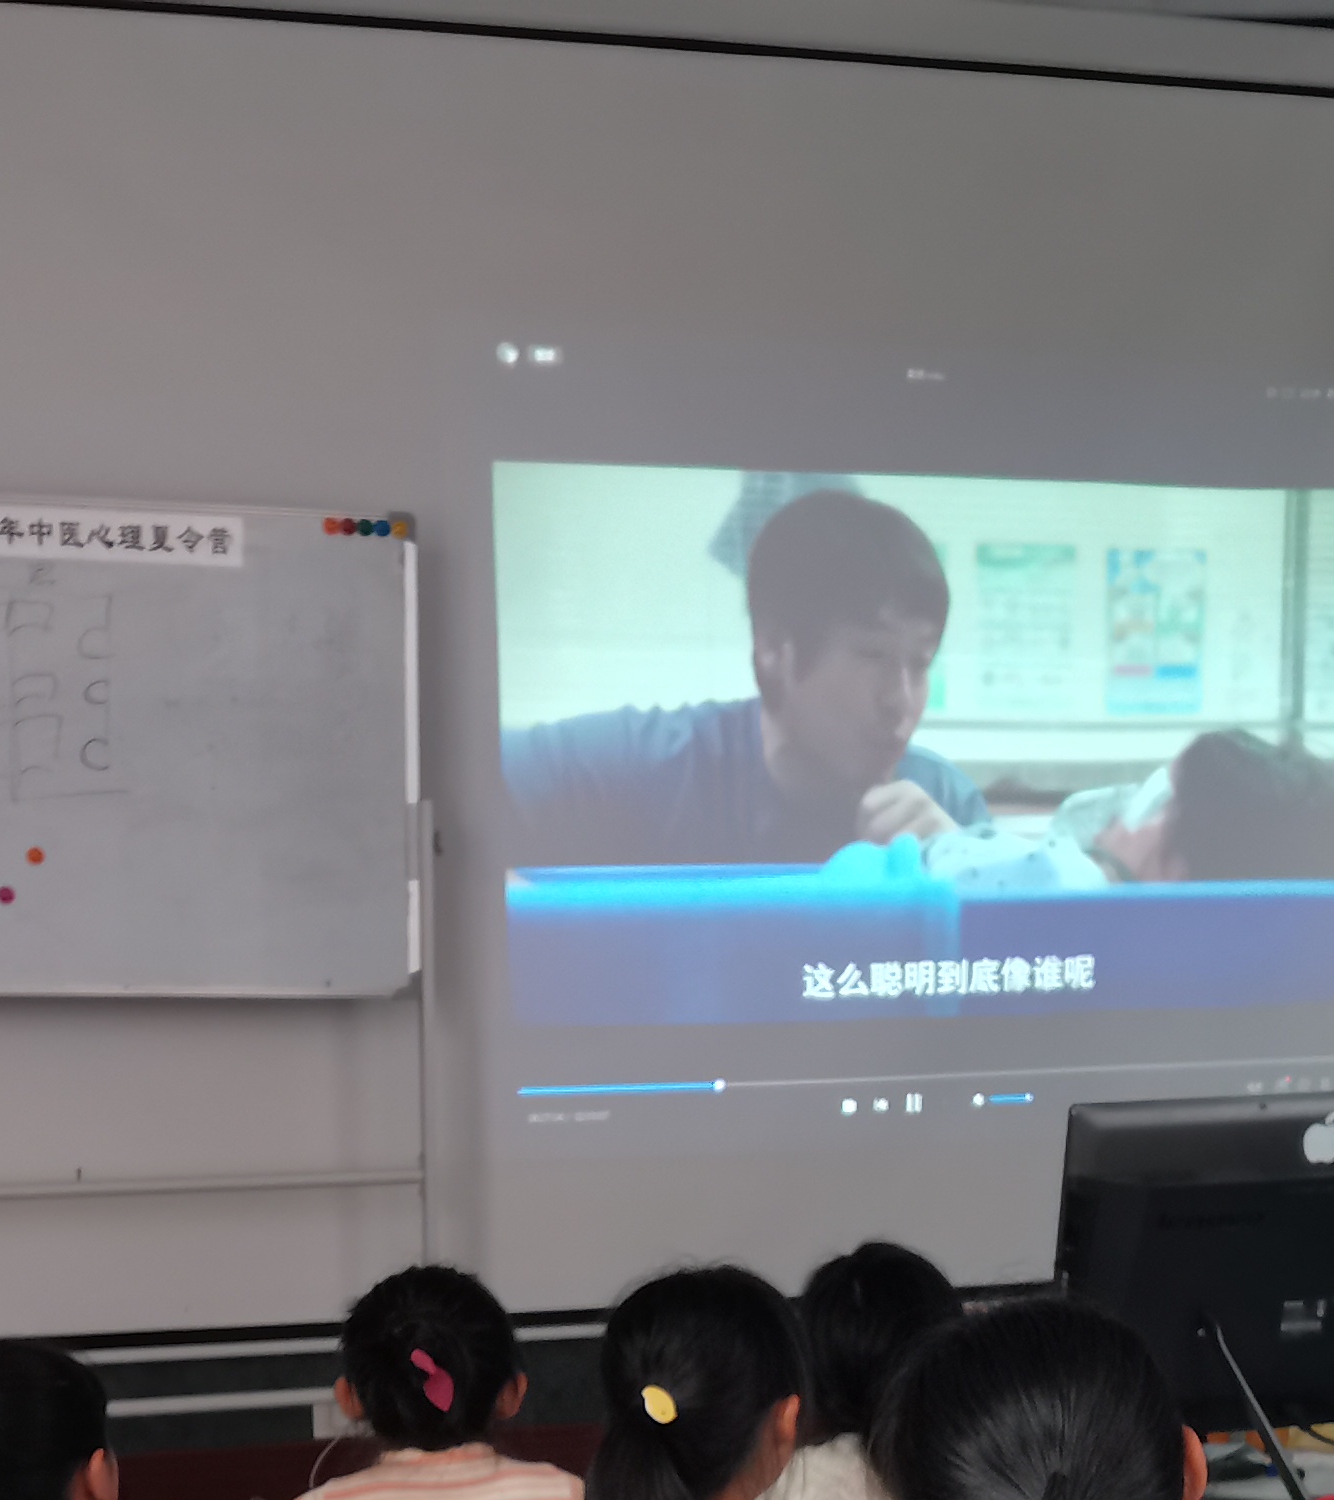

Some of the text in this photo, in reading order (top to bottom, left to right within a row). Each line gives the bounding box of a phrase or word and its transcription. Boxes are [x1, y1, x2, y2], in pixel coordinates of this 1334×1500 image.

[801, 953, 1097, 1000] 这么聪明到底像谁呢
